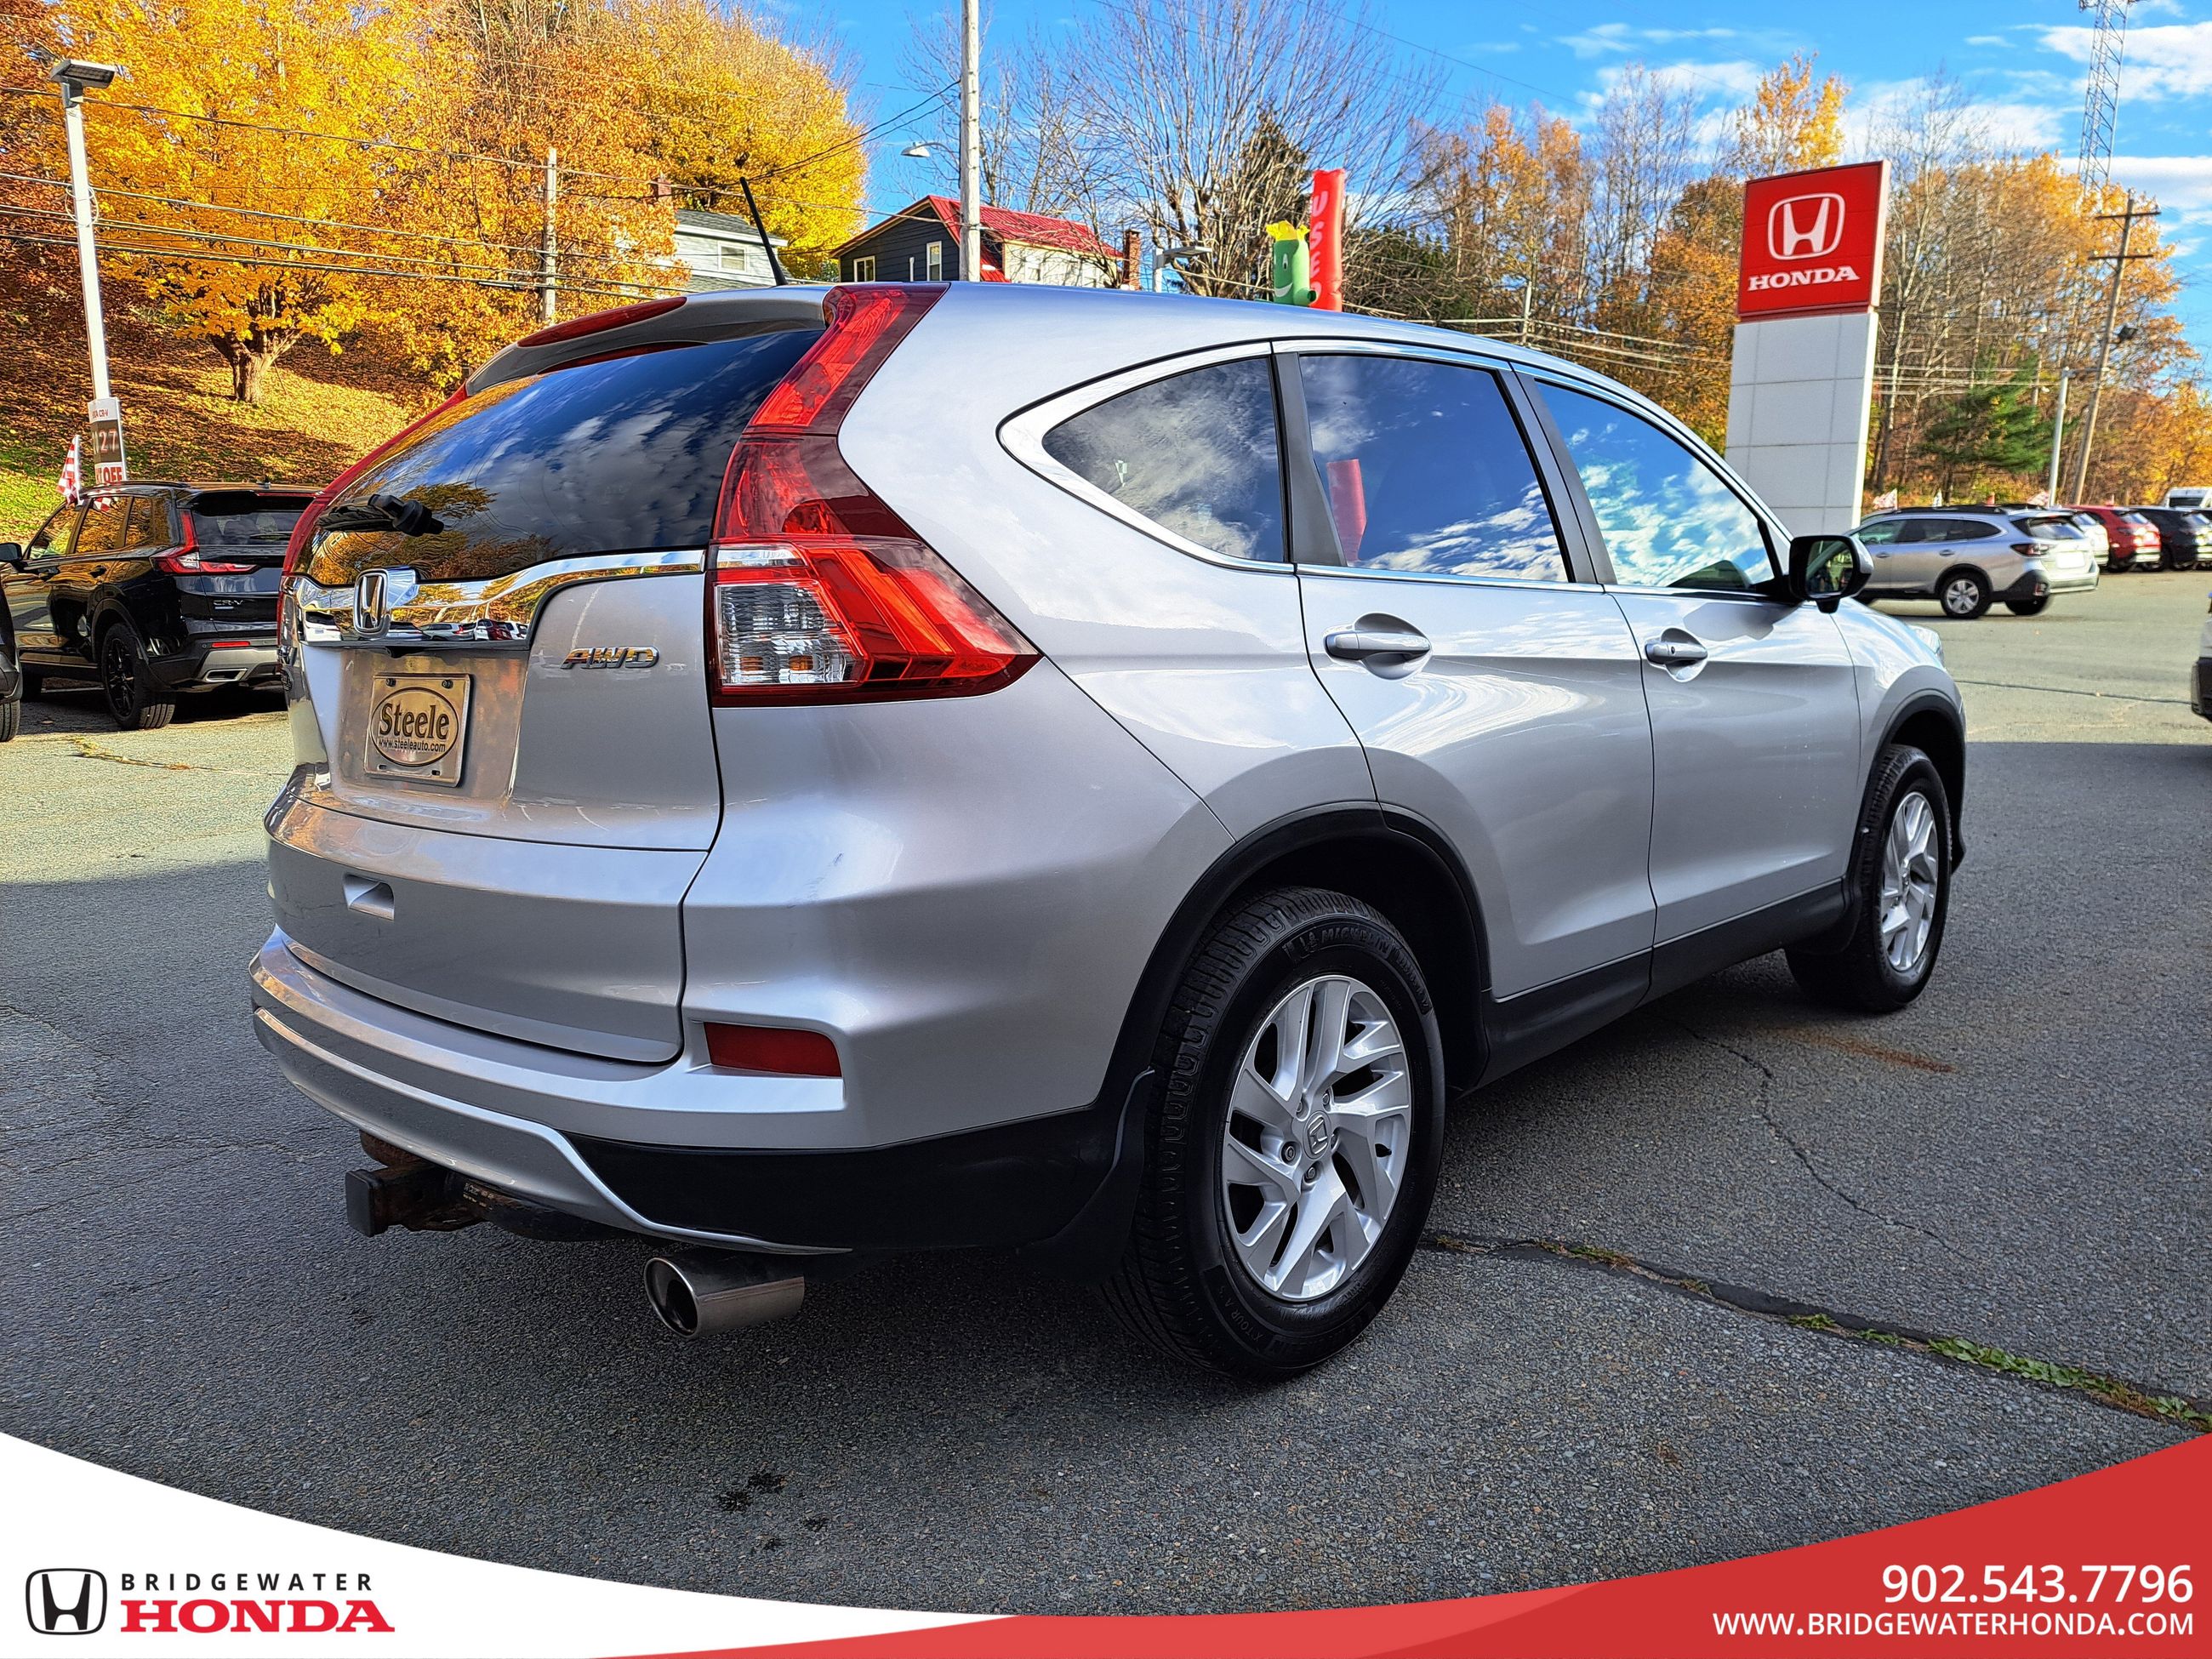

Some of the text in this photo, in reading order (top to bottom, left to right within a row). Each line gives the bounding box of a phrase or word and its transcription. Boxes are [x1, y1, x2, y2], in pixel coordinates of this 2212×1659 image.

[1747, 265, 1861, 292] HONDA
[560, 646, 659, 670] AWD
[379, 701, 450, 740] Steele
[378, 737, 447, 753] www.steeleauto.com
